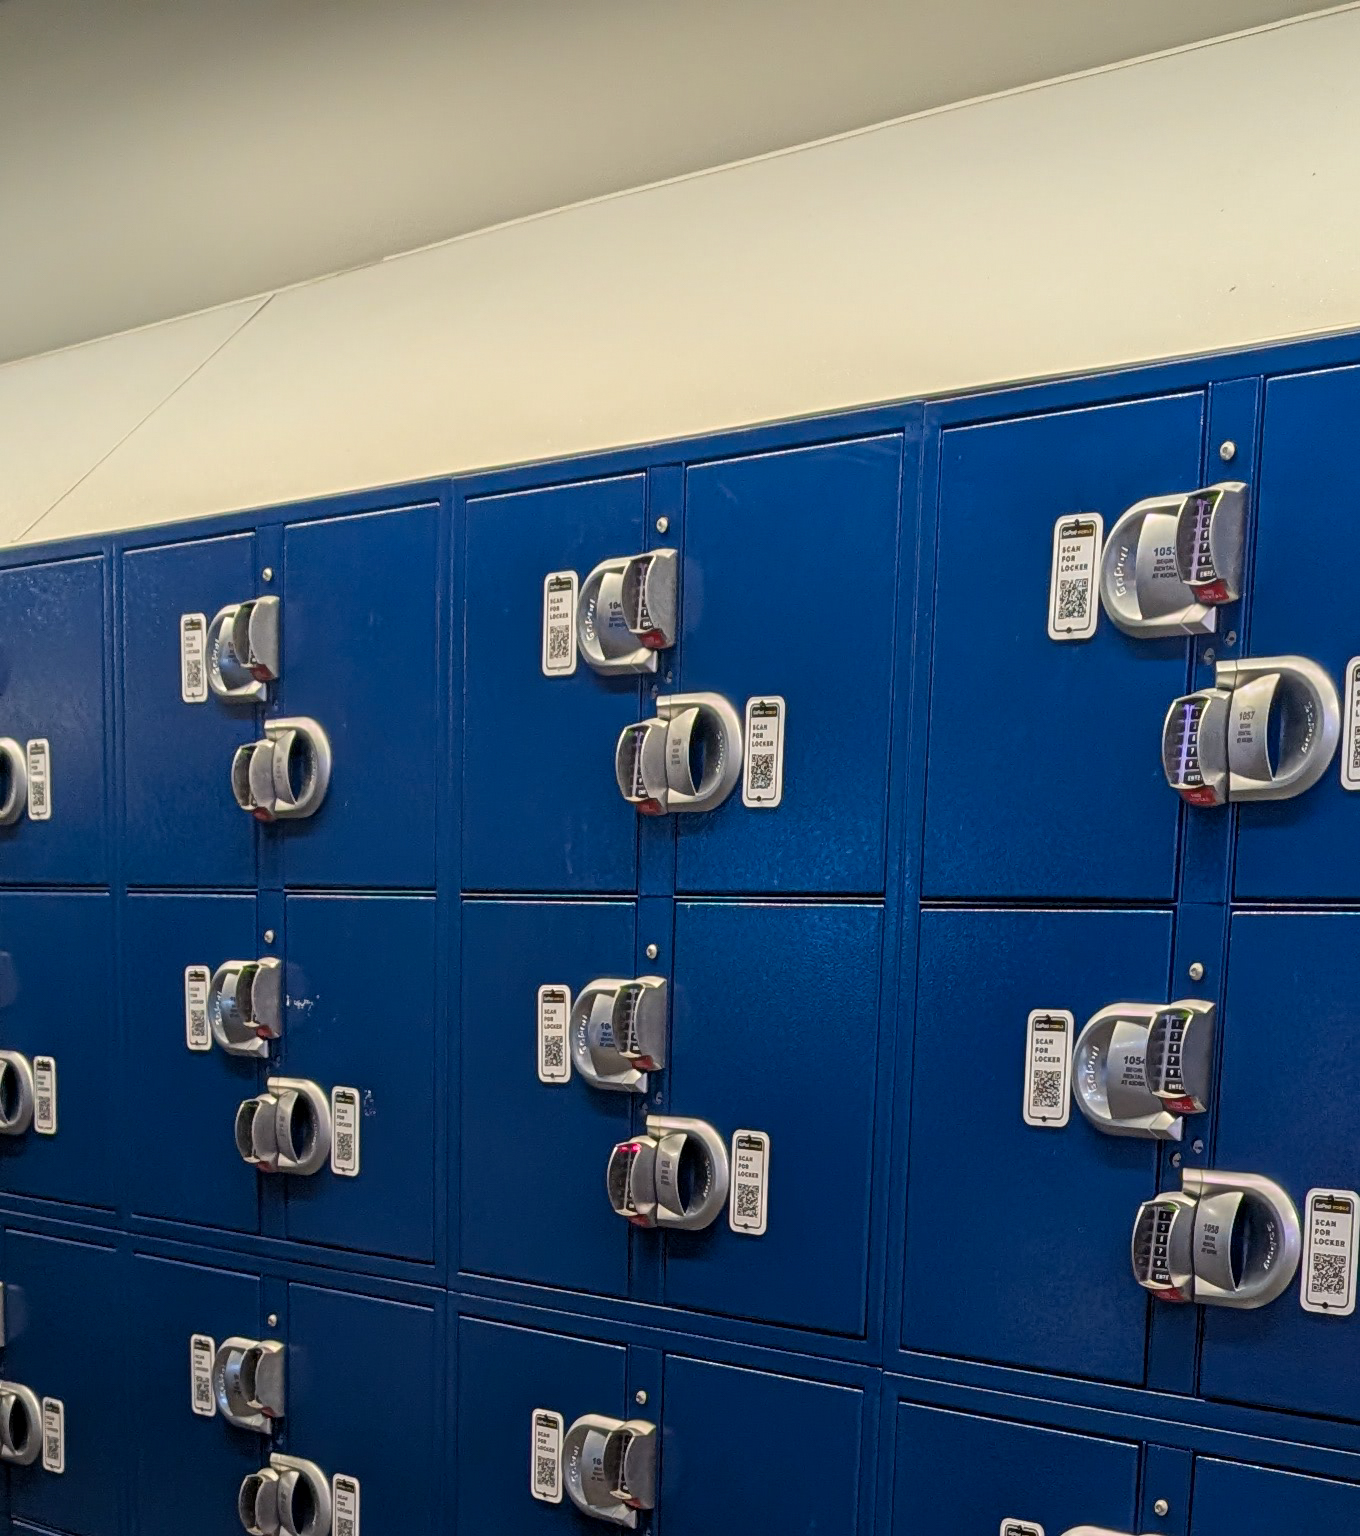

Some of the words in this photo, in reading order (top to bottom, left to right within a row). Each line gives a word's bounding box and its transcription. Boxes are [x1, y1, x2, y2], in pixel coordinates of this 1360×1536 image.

[1062, 545, 1081, 553] SCAN
[1061, 564, 1088, 572] LOCKER
[1315, 1228, 1331, 1236] FOR
[1314, 1238, 1346, 1247] LOCKER
